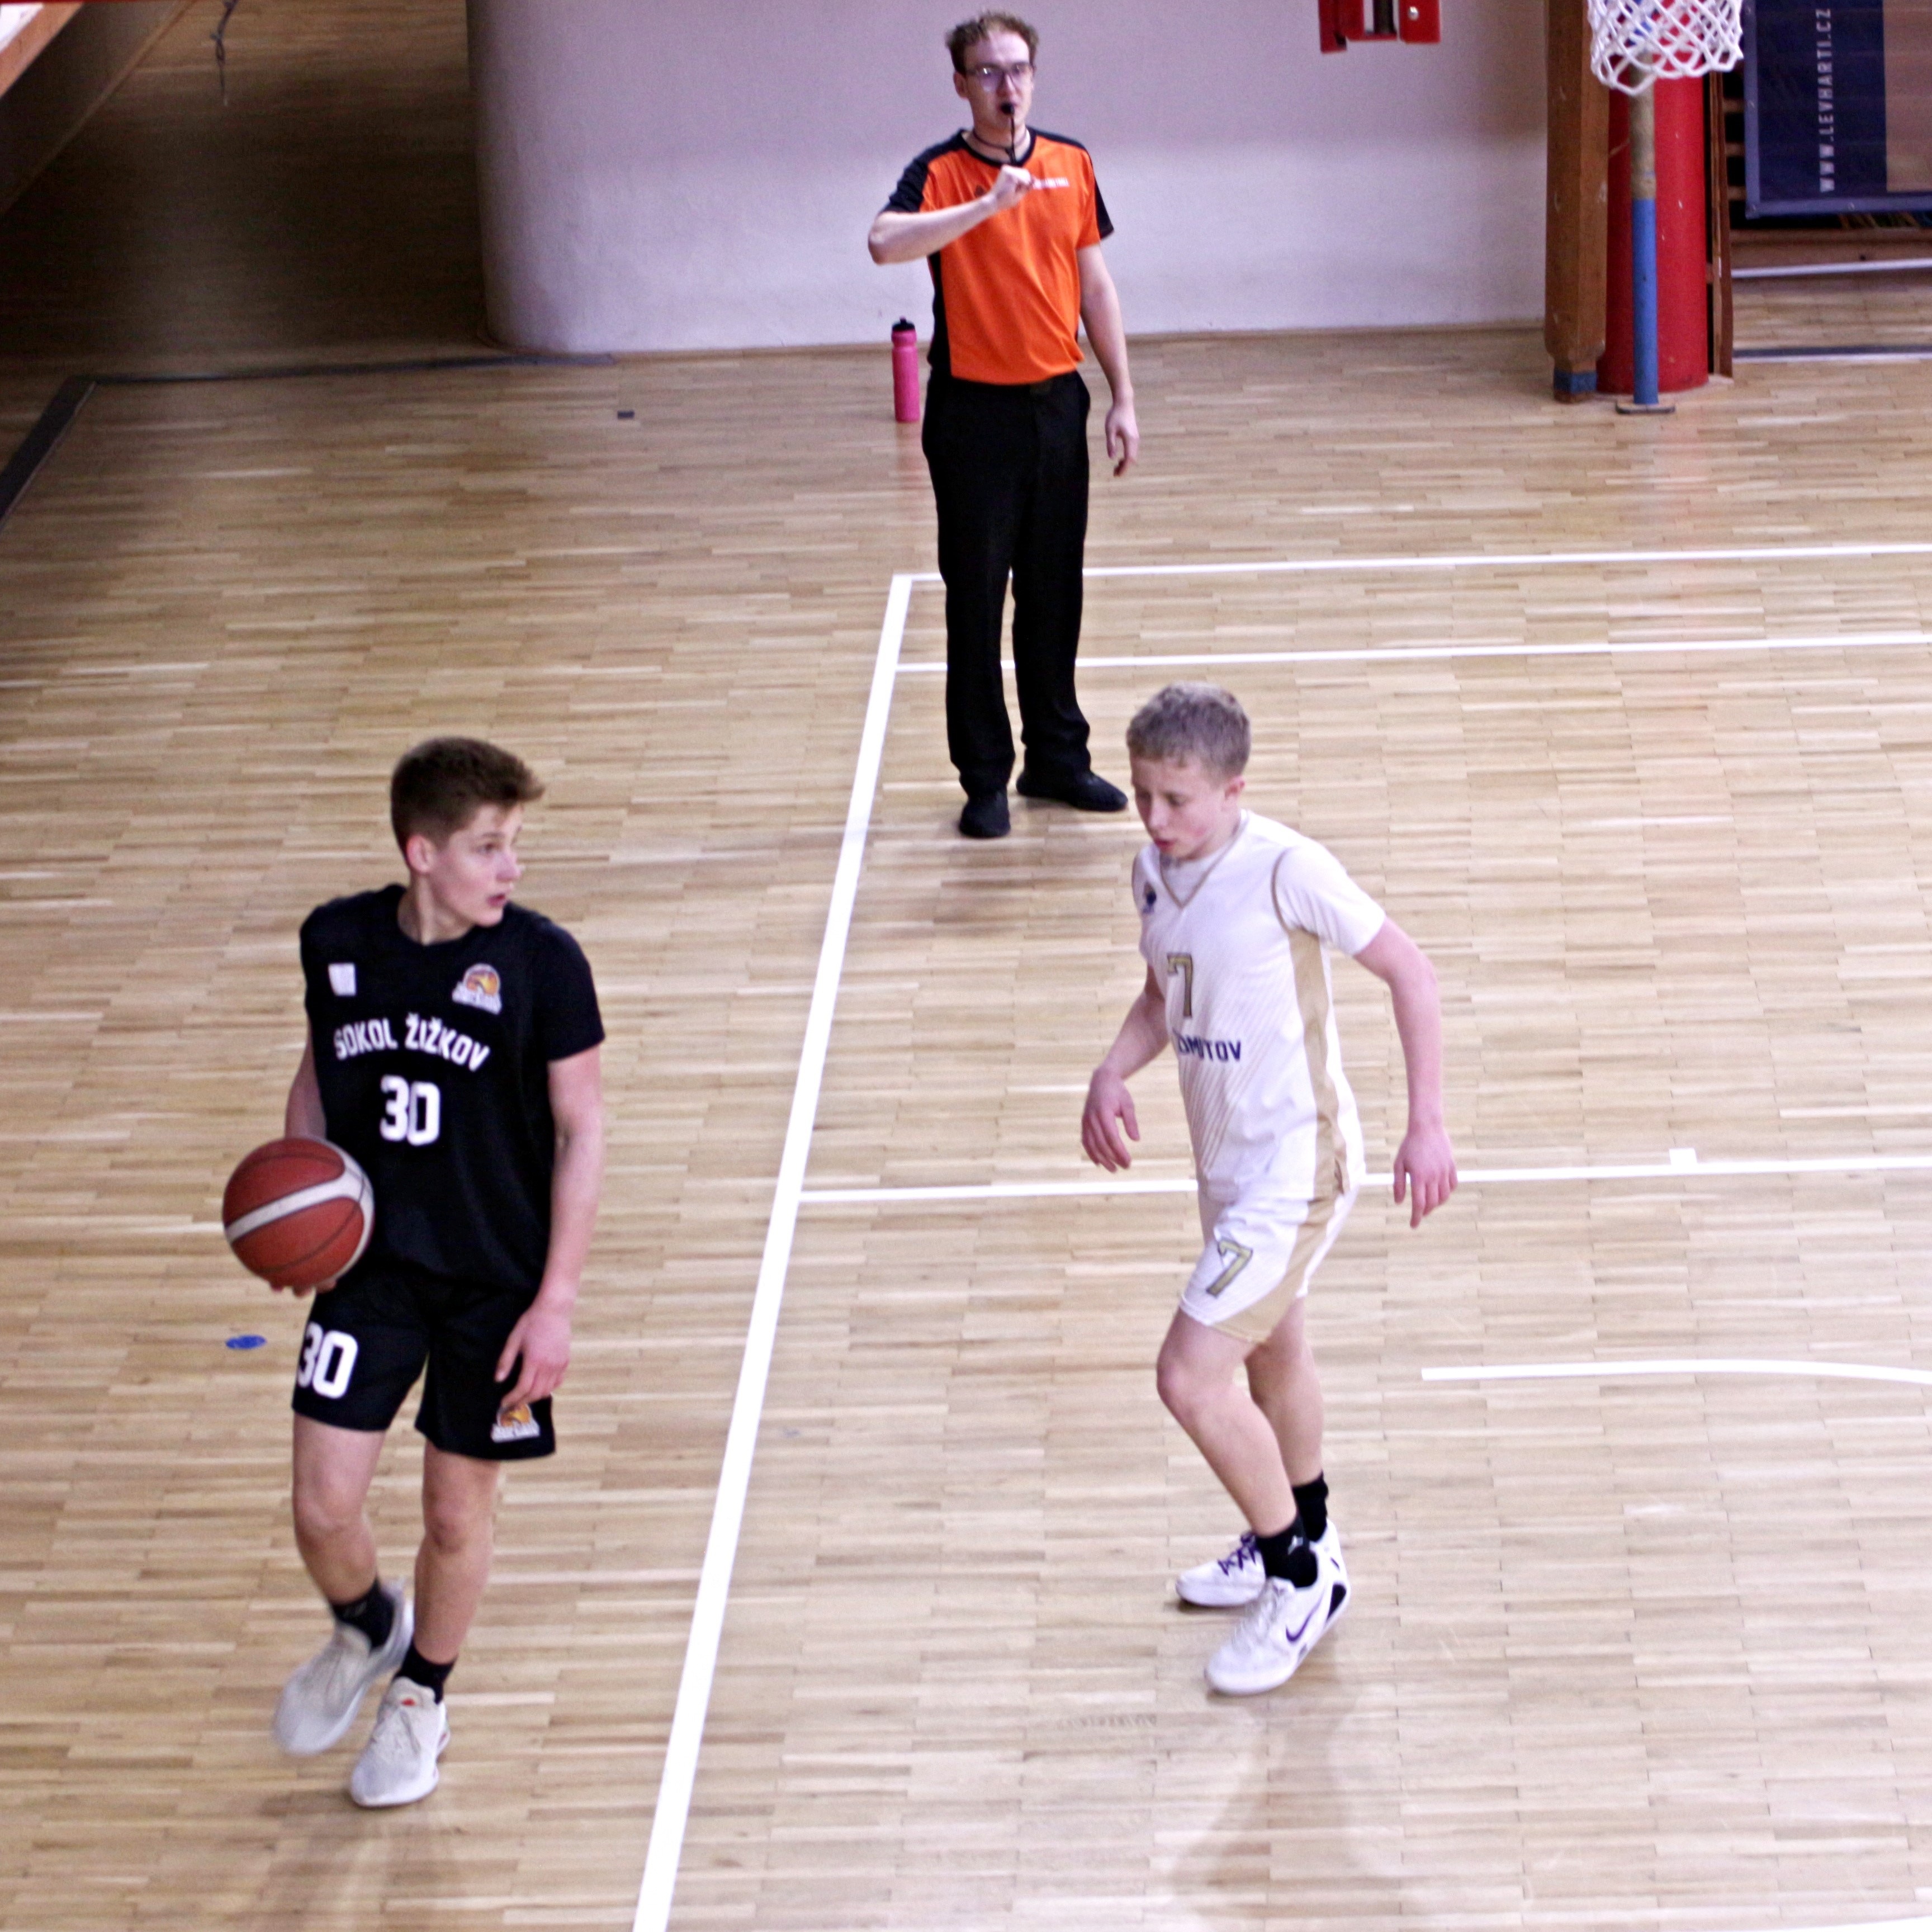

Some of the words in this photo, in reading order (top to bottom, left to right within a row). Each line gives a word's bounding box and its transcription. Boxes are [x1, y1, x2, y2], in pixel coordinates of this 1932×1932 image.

[1816, 8, 1835, 192] WWW.LEVHARTI.CZ
[1167, 954, 1192, 1017] 7
[334, 1018, 398, 1060] SOKOL
[405, 1012, 490, 1072] ŽIŽKOV
[380, 1075, 441, 1145] 30
[1206, 1238, 1253, 1299] 7
[297, 1323, 358, 1399] 30
